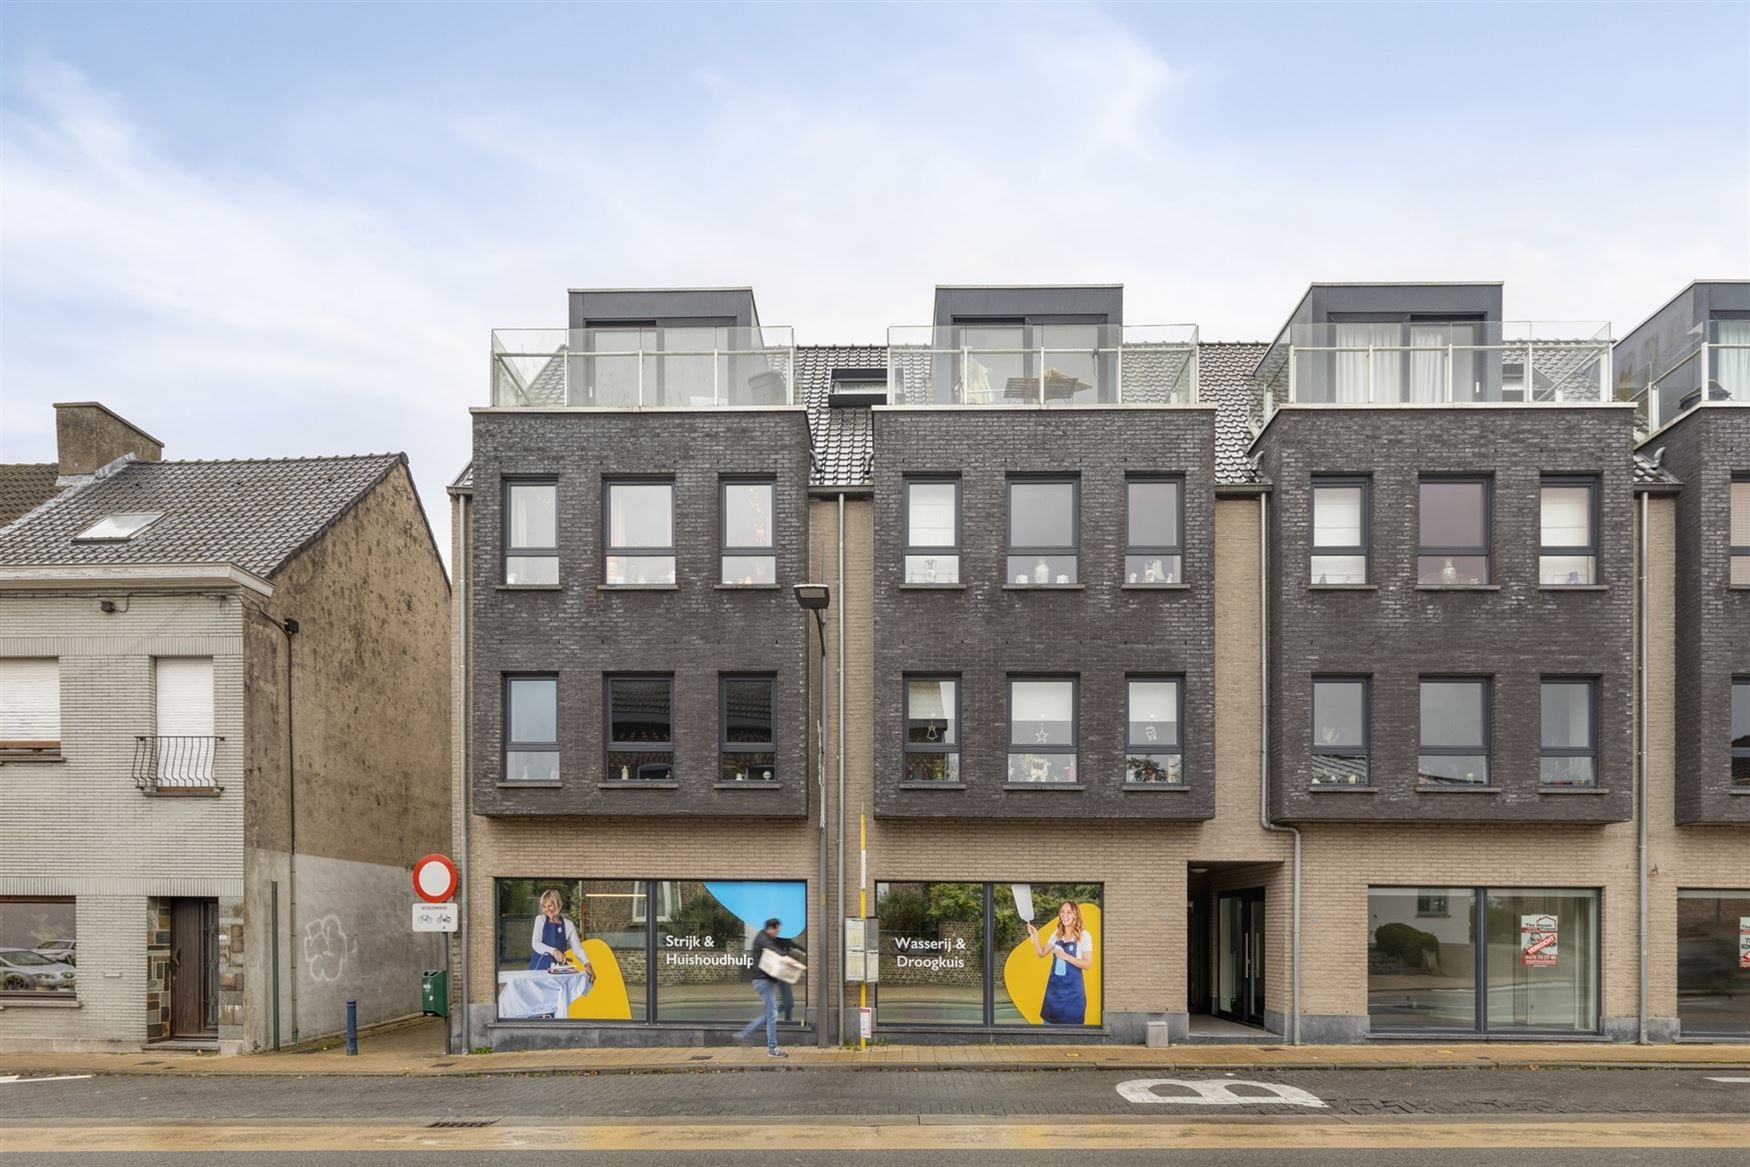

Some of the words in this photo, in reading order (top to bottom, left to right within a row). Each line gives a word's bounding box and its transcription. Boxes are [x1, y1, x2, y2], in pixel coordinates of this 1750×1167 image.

[665, 935, 701, 950] Strijk
[703, 935, 715, 947] &
[894, 937, 952, 953] Wasserij
[955, 937, 966, 950] &
[666, 953, 754, 969] Huishoudhulp
[897, 955, 965, 971] Droogkuis
